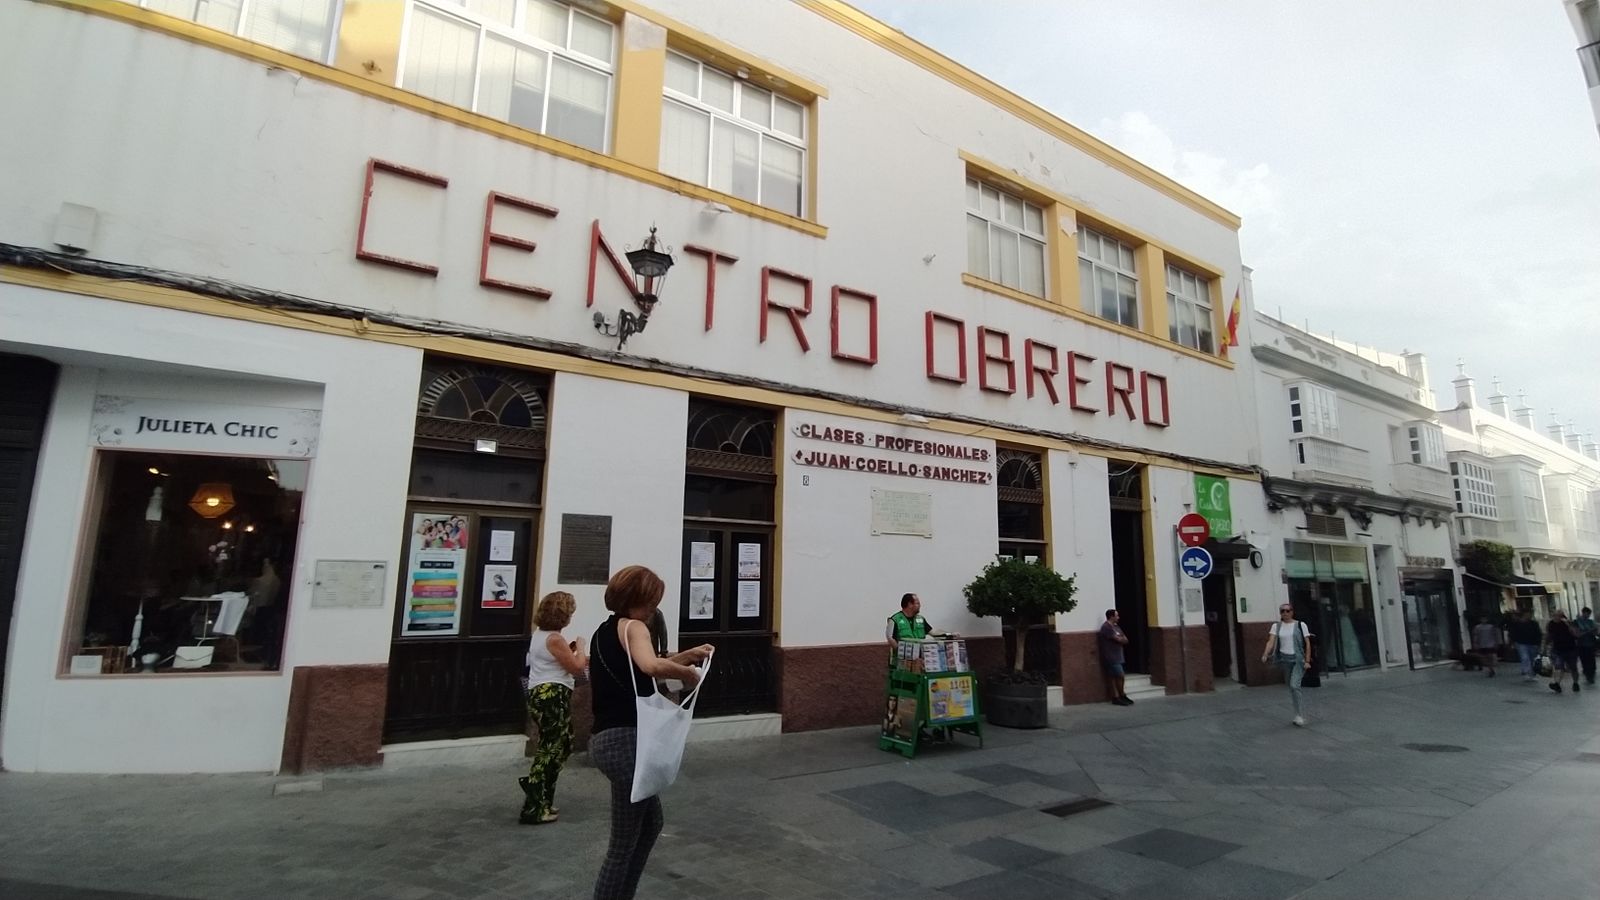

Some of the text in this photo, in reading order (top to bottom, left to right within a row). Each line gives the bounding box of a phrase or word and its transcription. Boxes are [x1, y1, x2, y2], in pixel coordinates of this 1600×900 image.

[356, 157, 1171, 428] CENTRO OBRERO
[136, 416, 279, 439] JULIETA CHIC
[800, 423, 989, 461] CLASES PROFESIONALES
[804, 451, 987, 484] JUAN COELLO SANCHEZ
